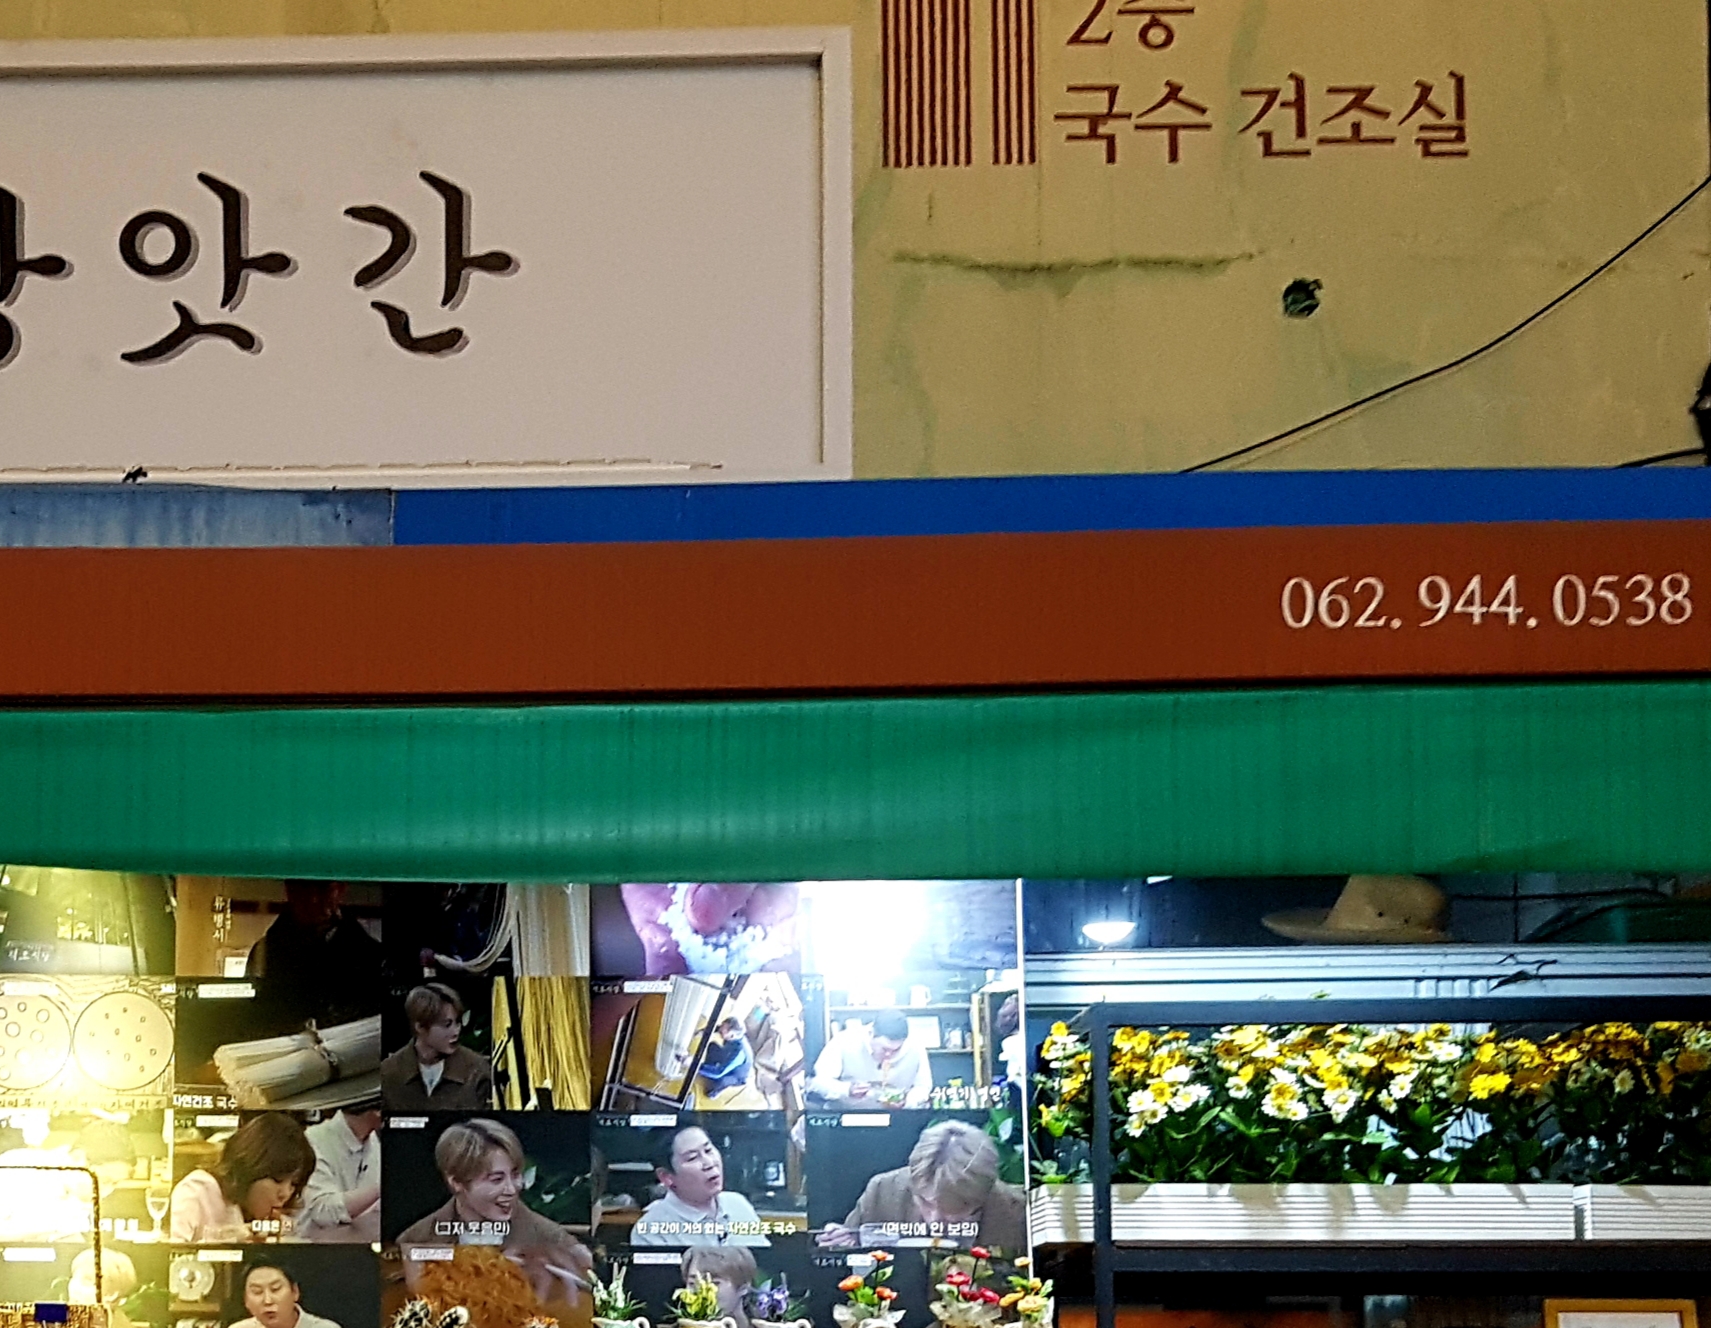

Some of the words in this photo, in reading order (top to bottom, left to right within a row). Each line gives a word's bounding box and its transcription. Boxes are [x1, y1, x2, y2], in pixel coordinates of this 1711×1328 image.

[1053, 79, 1212, 165] 국수
[1238, 70, 1471, 160] 건조실
[172, 1094, 214, 1109] 자연건조
[217, 1094, 238, 1109] 국수
[435, 1221, 465, 1237] (그저
[650, 1221, 681, 1236] 공간이
